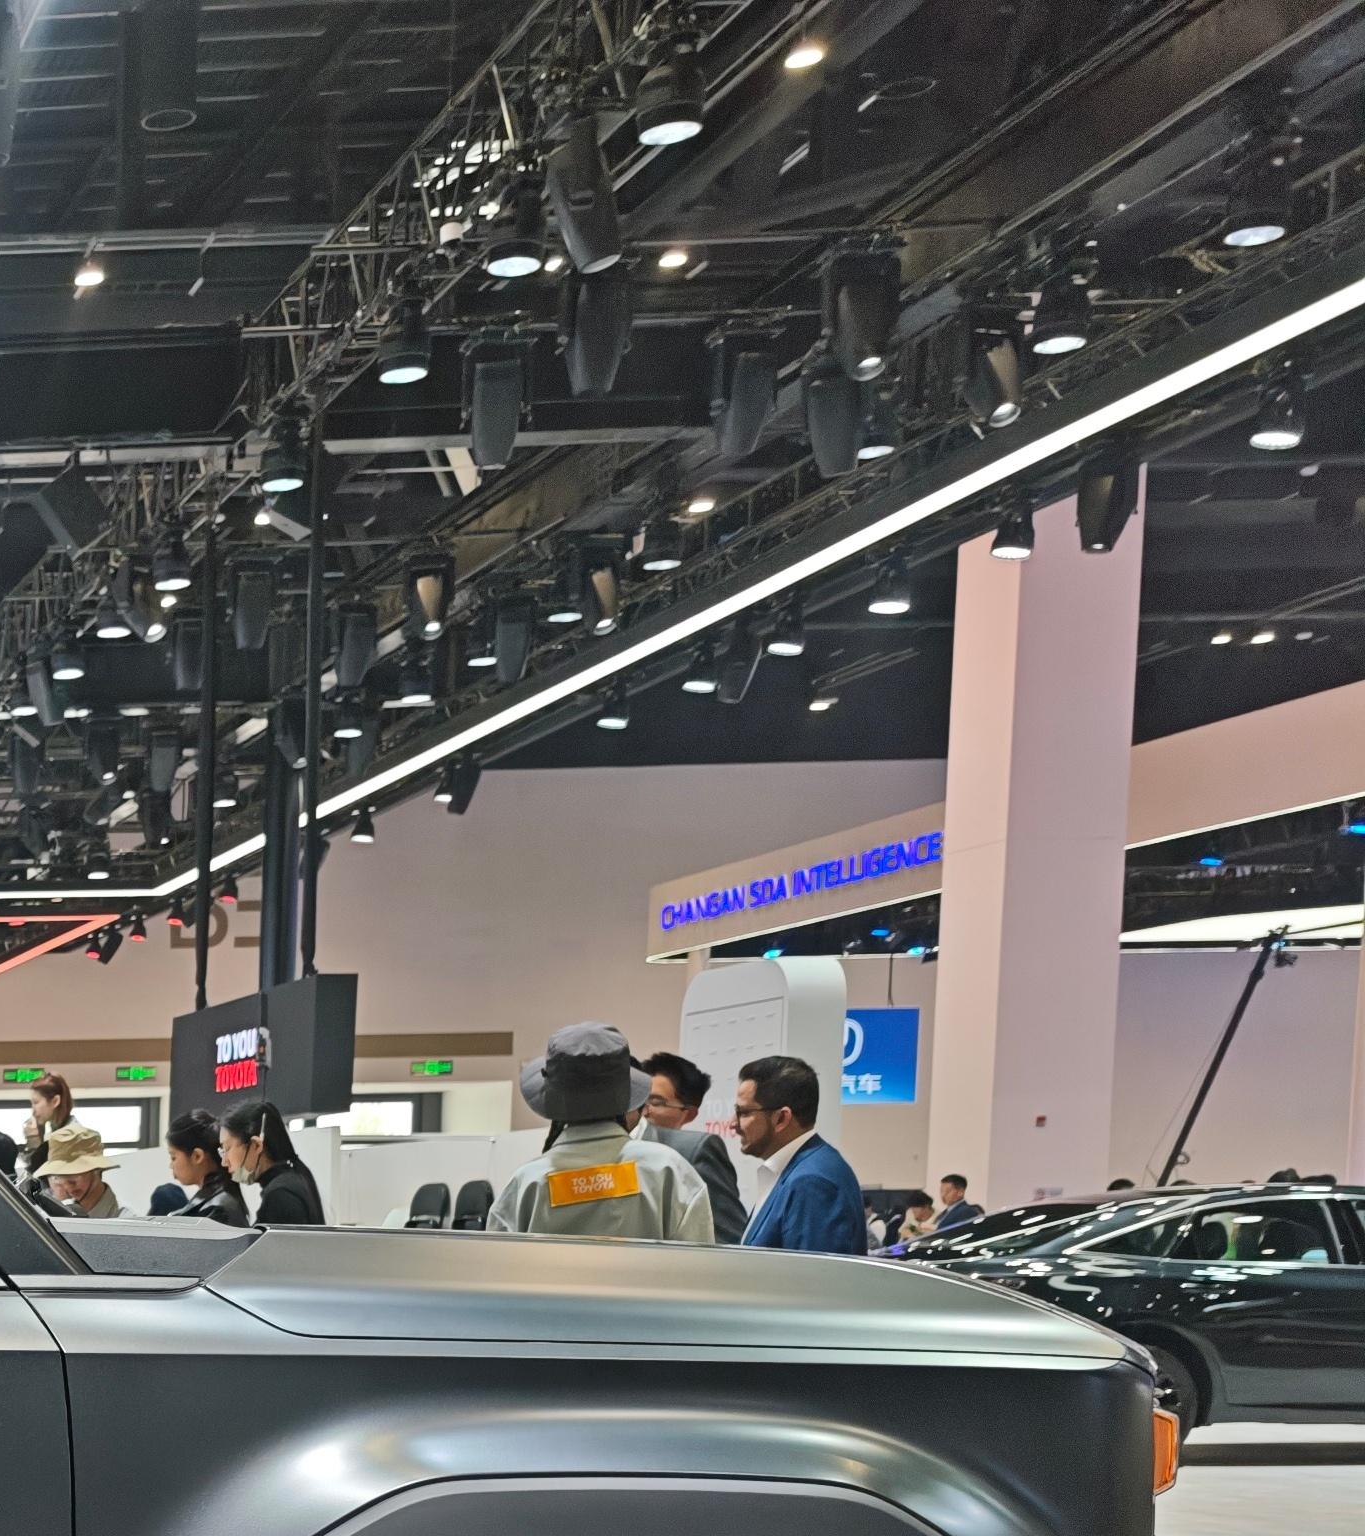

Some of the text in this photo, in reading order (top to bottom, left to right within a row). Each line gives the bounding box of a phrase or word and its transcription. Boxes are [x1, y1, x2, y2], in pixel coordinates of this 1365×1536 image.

[661, 886, 747, 931] CHANGAN
[791, 831, 943, 897] INTELLIGENCE
[216, 1028, 258, 1064] TO YOU
[215, 1059, 258, 1093] TOYOTA
[572, 1172, 613, 1186] TO YOU
[573, 1181, 615, 1194] TOYOTA
